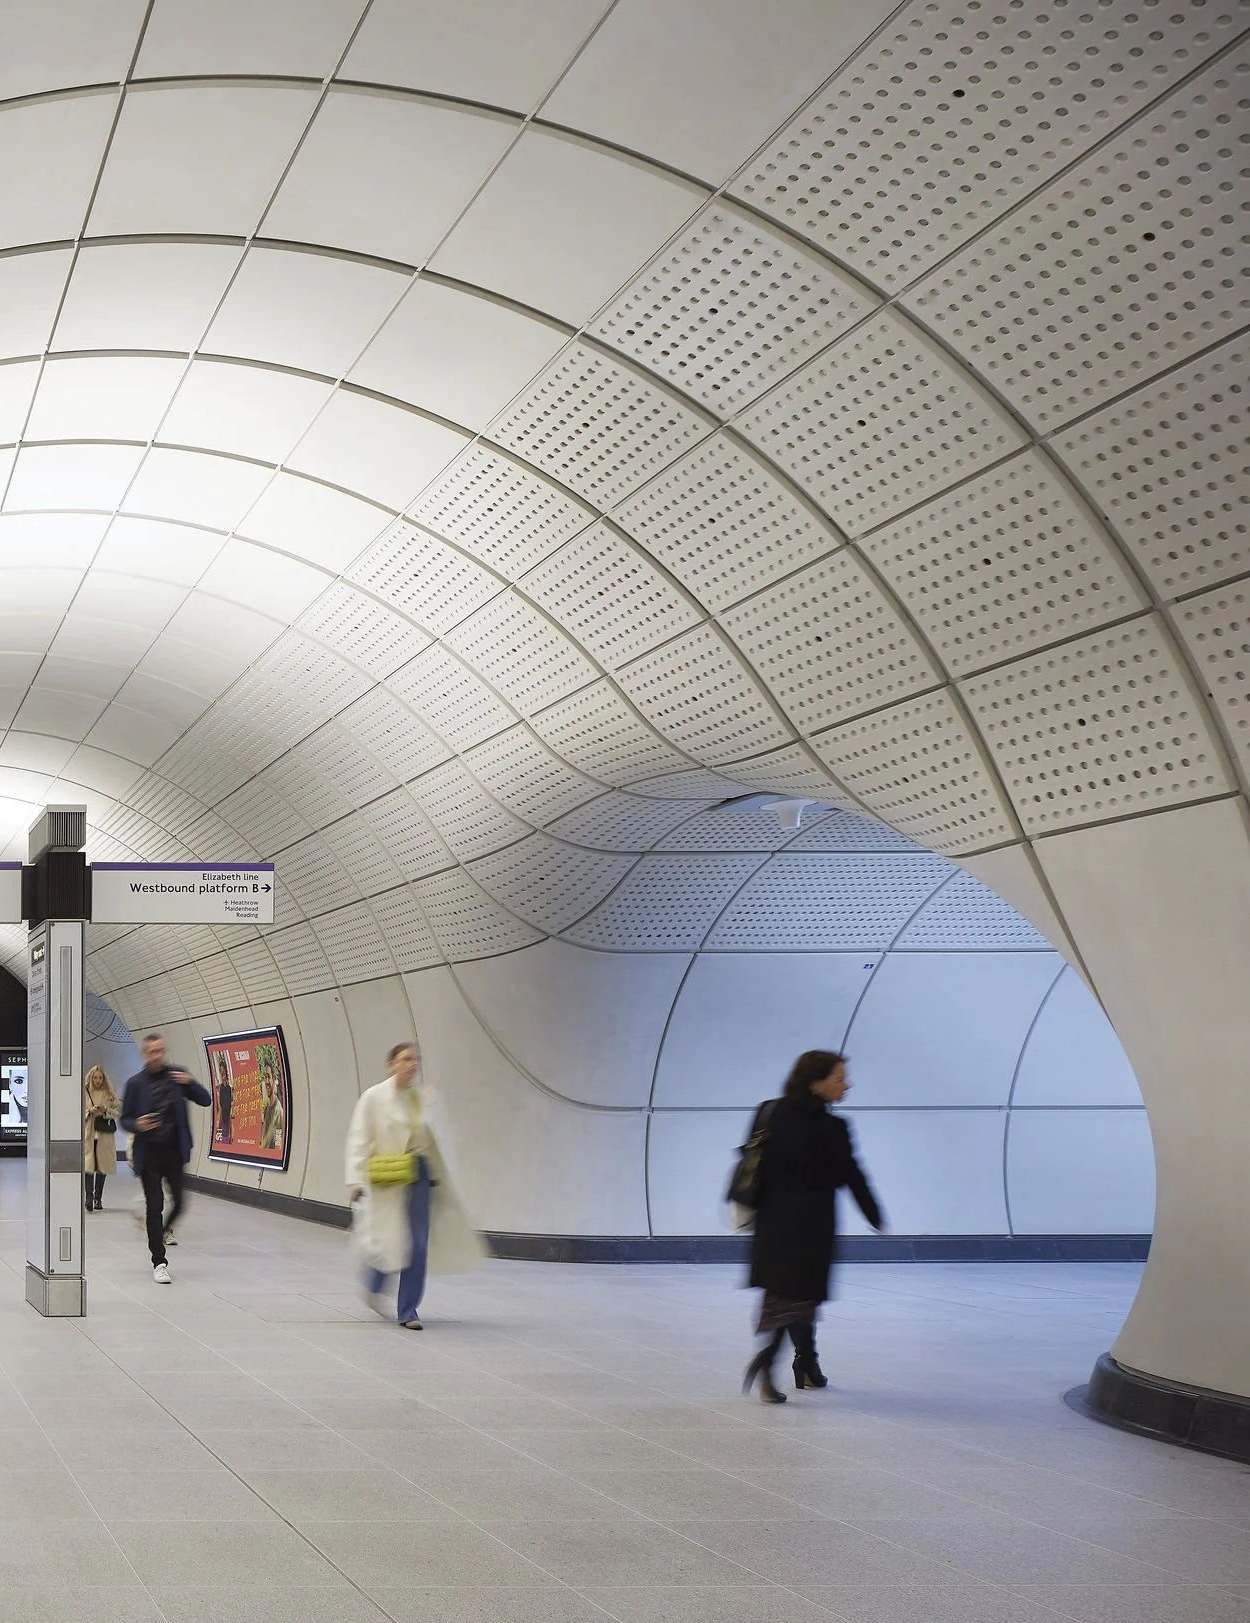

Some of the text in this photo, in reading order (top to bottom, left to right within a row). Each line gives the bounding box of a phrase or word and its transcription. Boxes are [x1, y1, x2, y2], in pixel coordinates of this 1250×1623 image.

[130, 883, 259, 895] Westbound platform B
